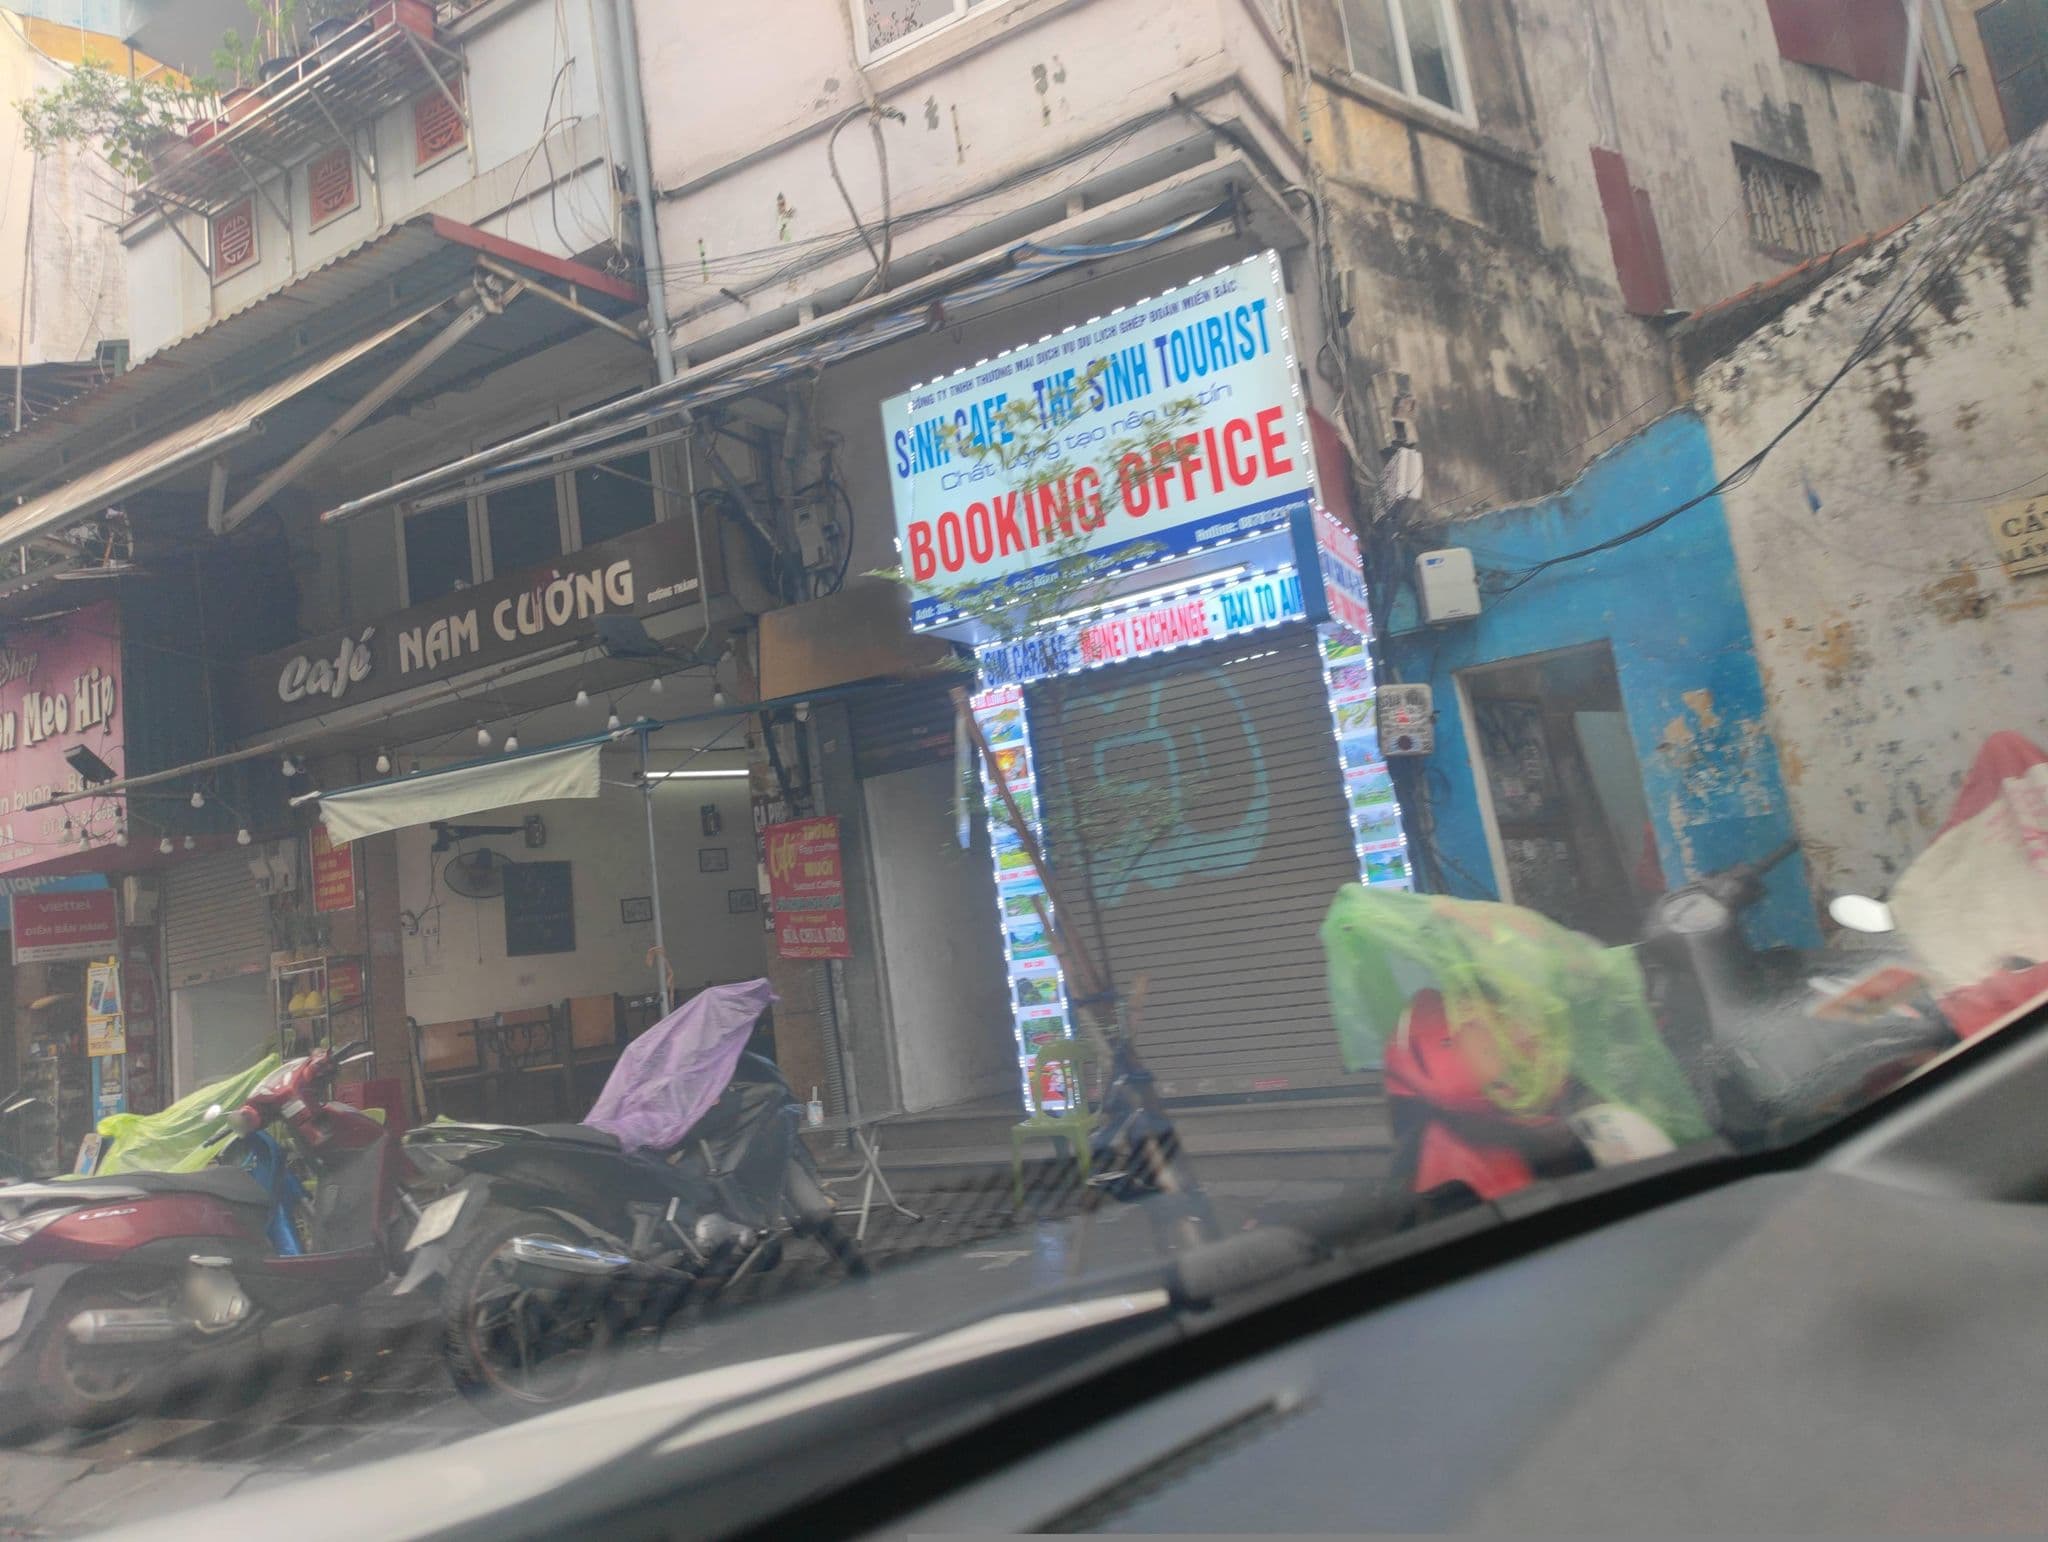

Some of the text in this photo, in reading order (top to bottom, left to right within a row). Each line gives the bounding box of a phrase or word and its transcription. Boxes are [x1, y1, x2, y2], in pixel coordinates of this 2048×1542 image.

[1153, 298, 1270, 388] TOURIST
[940, 456, 997, 491] Chất
[1063, 426, 1107, 452] tạo
[1111, 409, 1156, 435] nên
[1196, 382, 1233, 406] tín
[908, 405, 1294, 583] BOOKING OFFICE
[278, 558, 637, 704] Café NAM CƯỜNG
[1130, 599, 1210, 652] EXCHANGE
[1219, 588, 1255, 630] TAXI
[1255, 582, 1278, 620] TO
